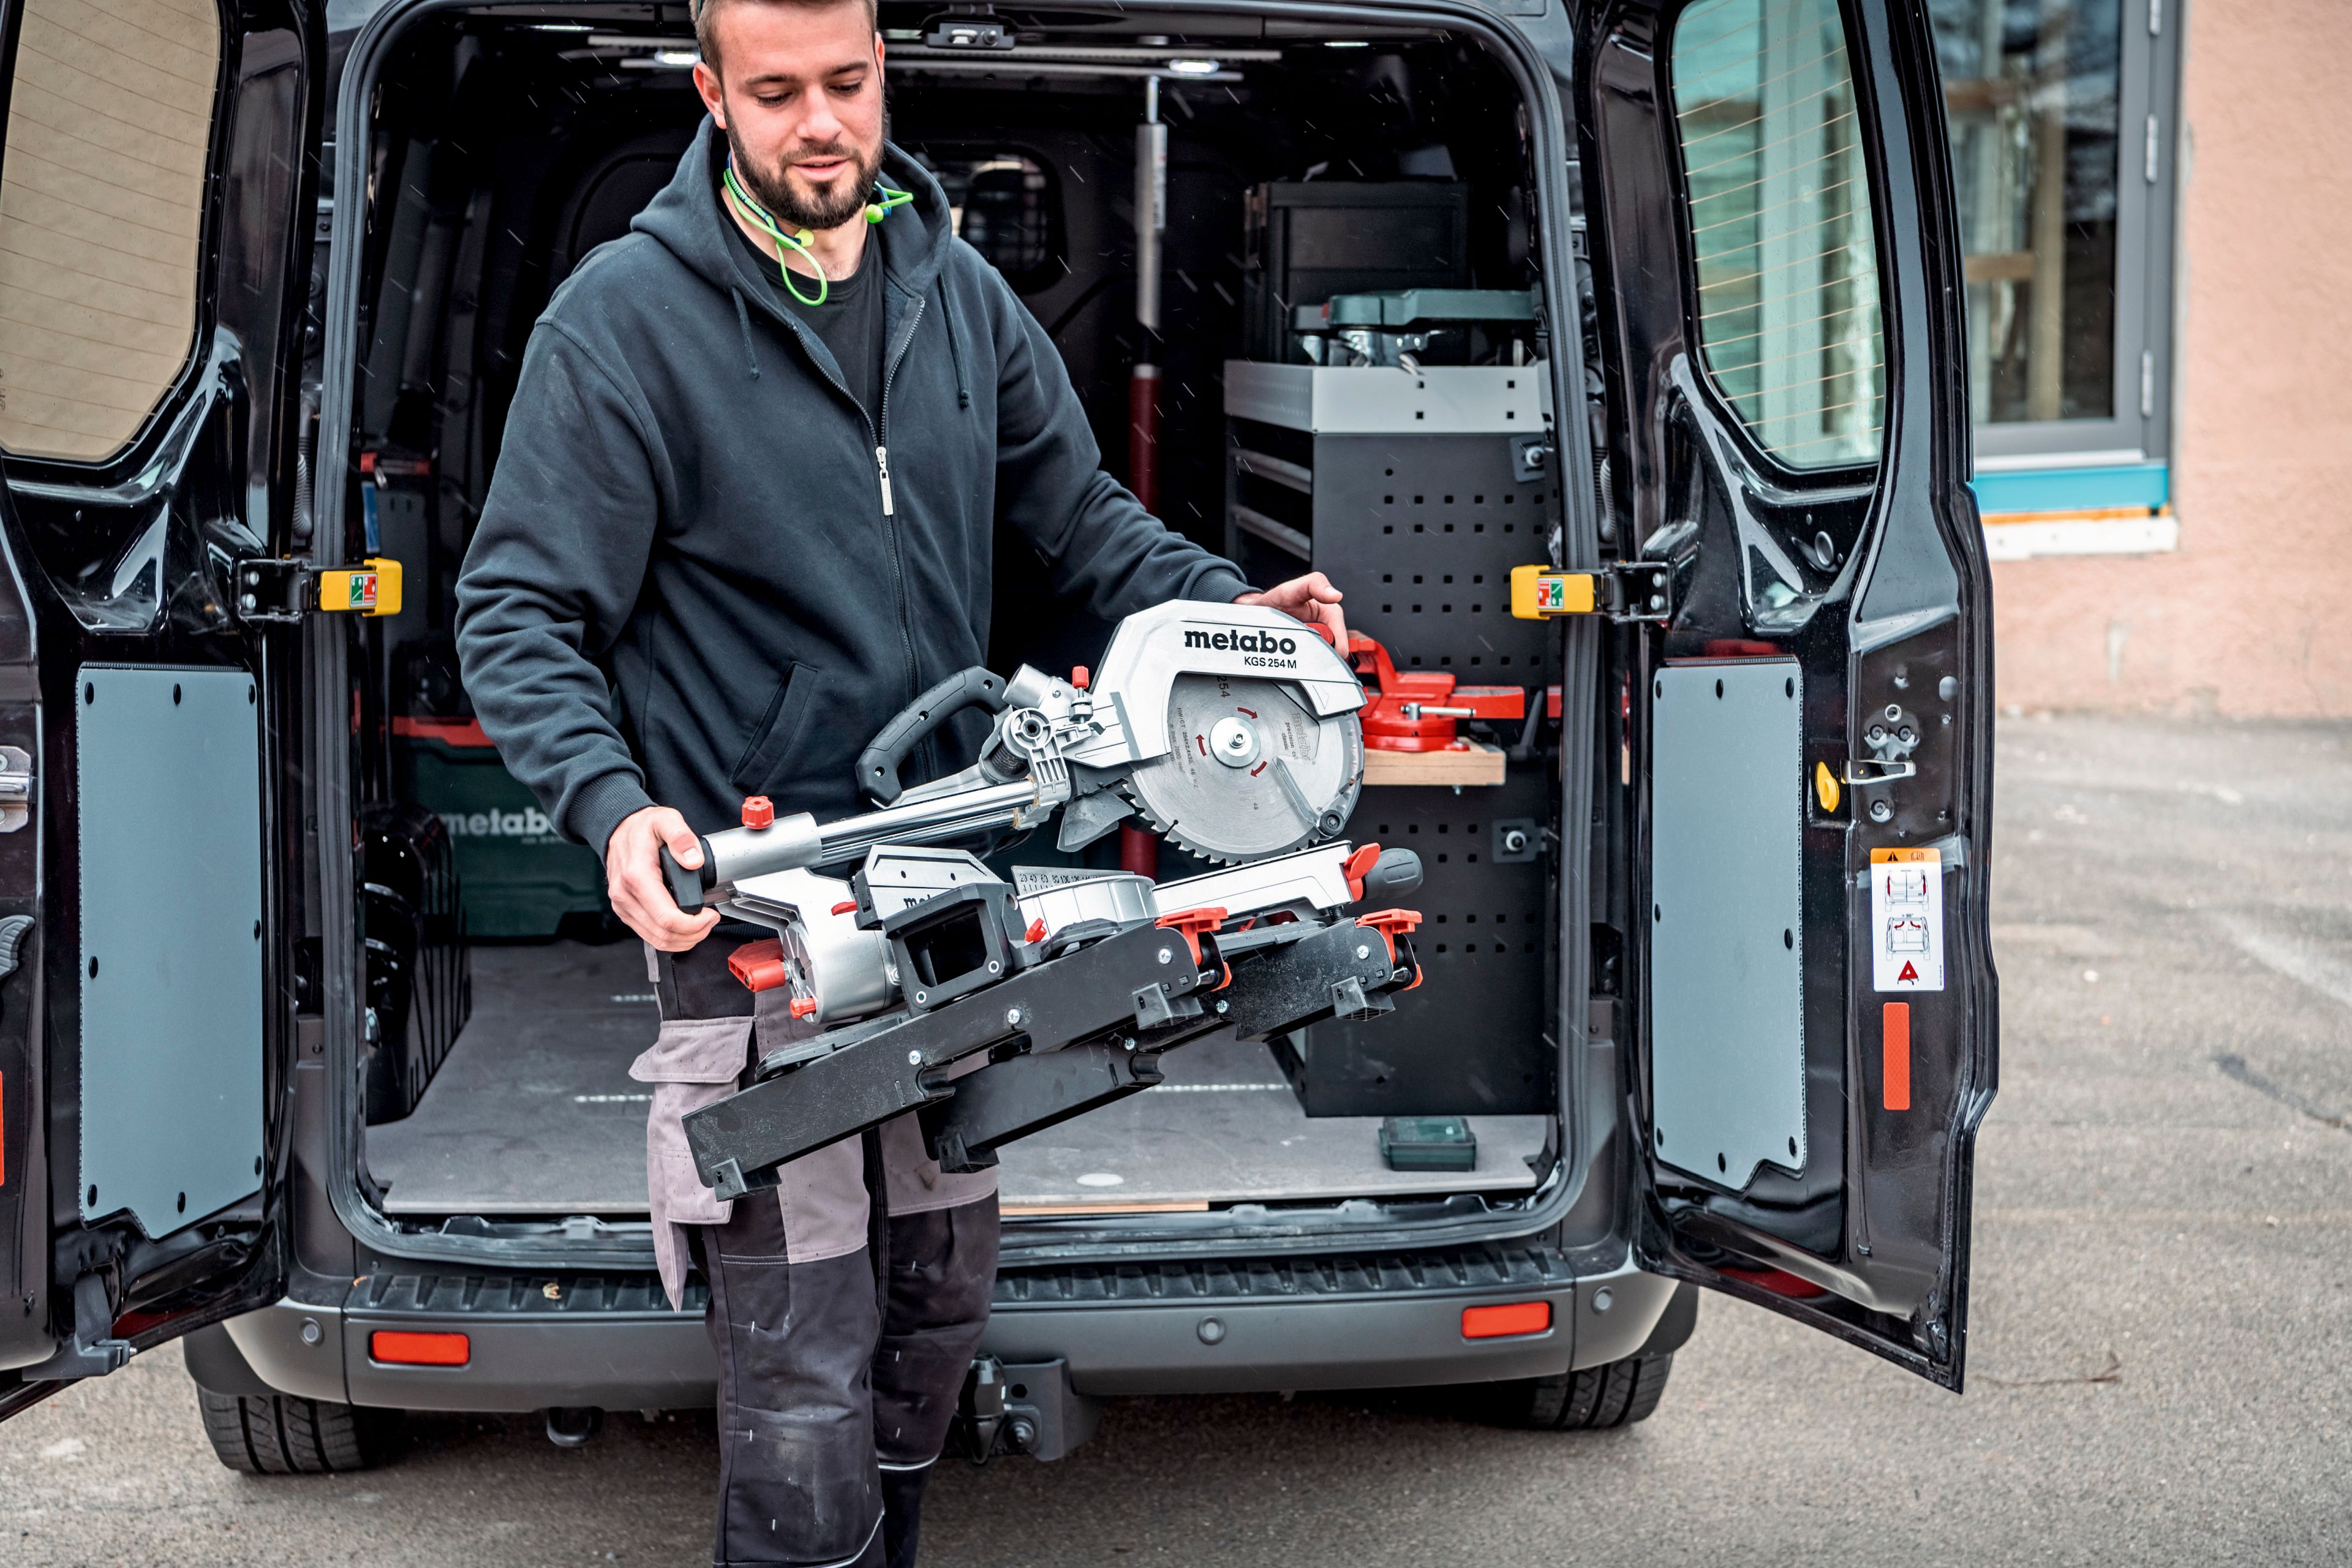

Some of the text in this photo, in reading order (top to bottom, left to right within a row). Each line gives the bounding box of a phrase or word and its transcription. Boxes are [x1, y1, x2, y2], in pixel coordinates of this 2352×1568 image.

[1185, 629, 1297, 655] metabo
[1245, 656, 1297, 669] KGS 254 M
[1216, 675, 1231, 698] 254
[1177, 707, 1186, 728] HW/CT
[1284, 722, 1295, 748] precision
[1292, 713, 1311, 764] metabo
[437, 806, 557, 836] metab
[1020, 873, 1028, 882] 20
[1030, 874, 1037, 883] 40
[1052, 875, 1060, 883] 80
